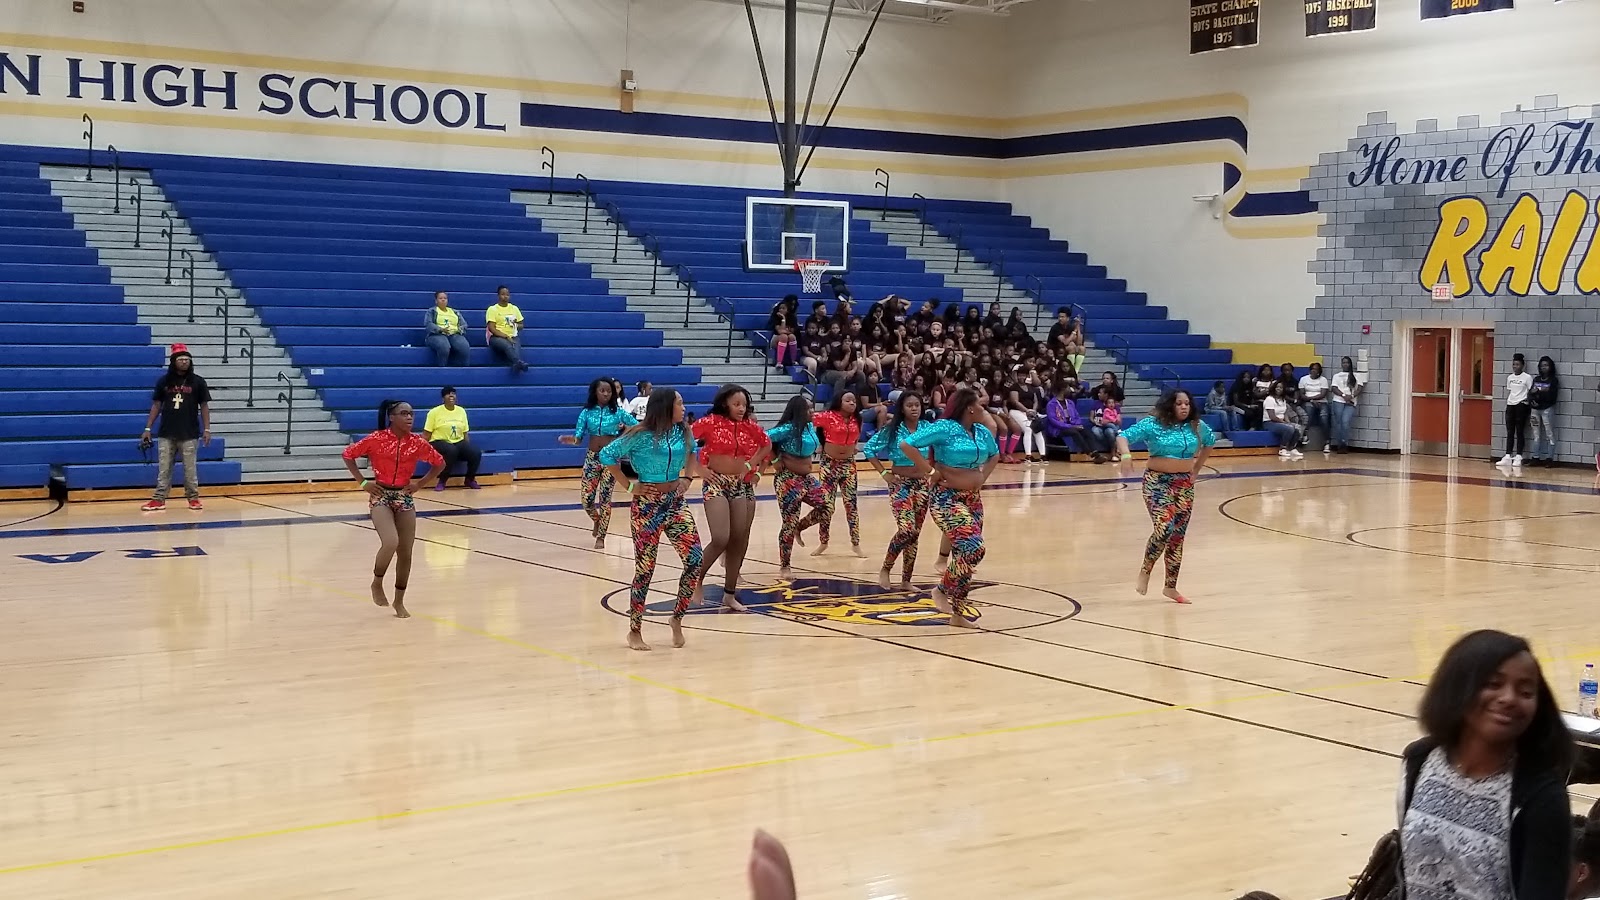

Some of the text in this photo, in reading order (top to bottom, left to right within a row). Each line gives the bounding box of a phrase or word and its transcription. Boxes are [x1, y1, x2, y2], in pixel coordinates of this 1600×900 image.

[1190, 0, 1259, 17] STATE CHAMPS
[1193, 12, 1255, 33] BOYS BASKETBALL
[1328, 15, 1349, 28] 1991
[1213, 31, 1233, 44] 1975
[65, 57, 239, 111] HIGH
[257, 73, 507, 133] SCHOOL
[1348, 119, 1600, 198] Home Of Th
[1435, 287, 1448, 298] EXIT
